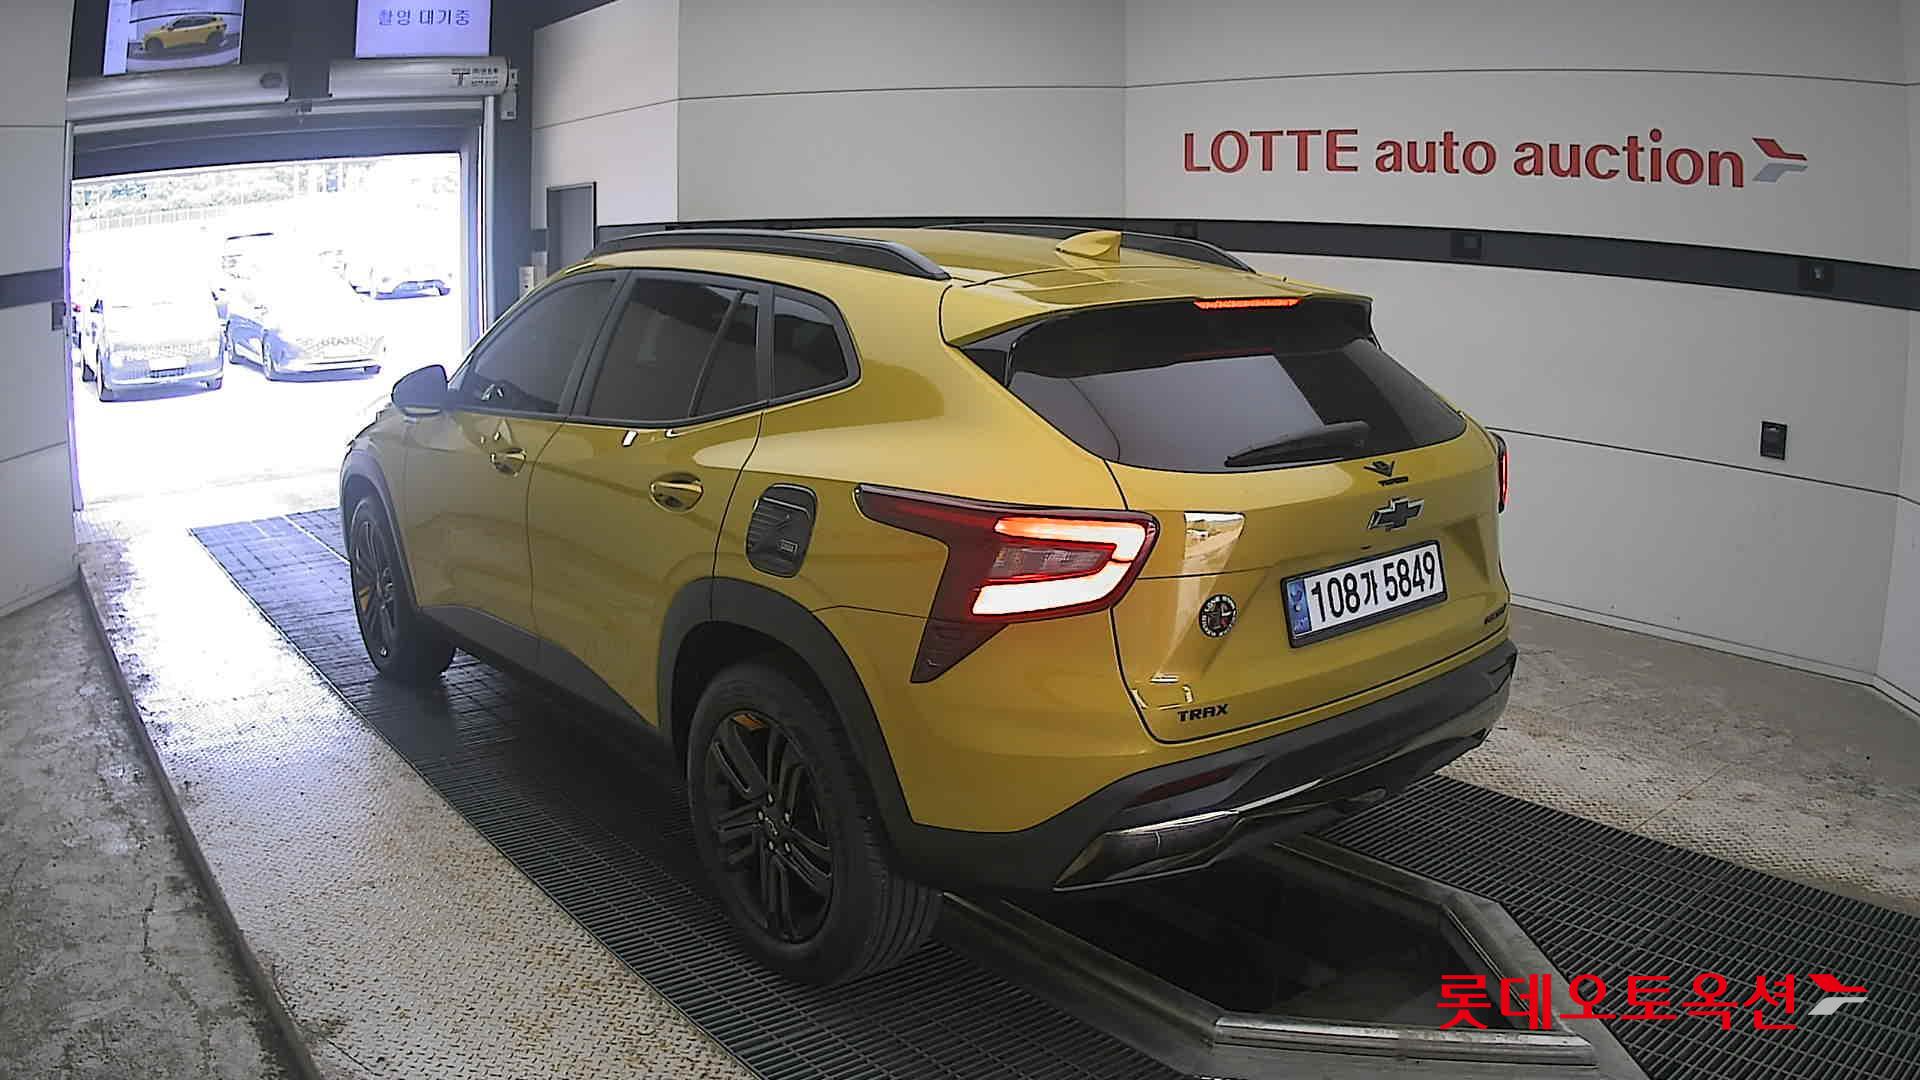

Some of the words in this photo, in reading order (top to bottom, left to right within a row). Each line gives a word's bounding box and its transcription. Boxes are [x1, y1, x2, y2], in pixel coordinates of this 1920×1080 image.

[420, 9, 471, 26] 대기중
[1184, 129, 1358, 173] LOTTE
[1376, 132, 1496, 174] auto
[1514, 129, 1744, 188] auction
[1310, 569, 1379, 623] 108가
[1382, 550, 1436, 602] 5849
[1177, 703, 1229, 722] TRAX
